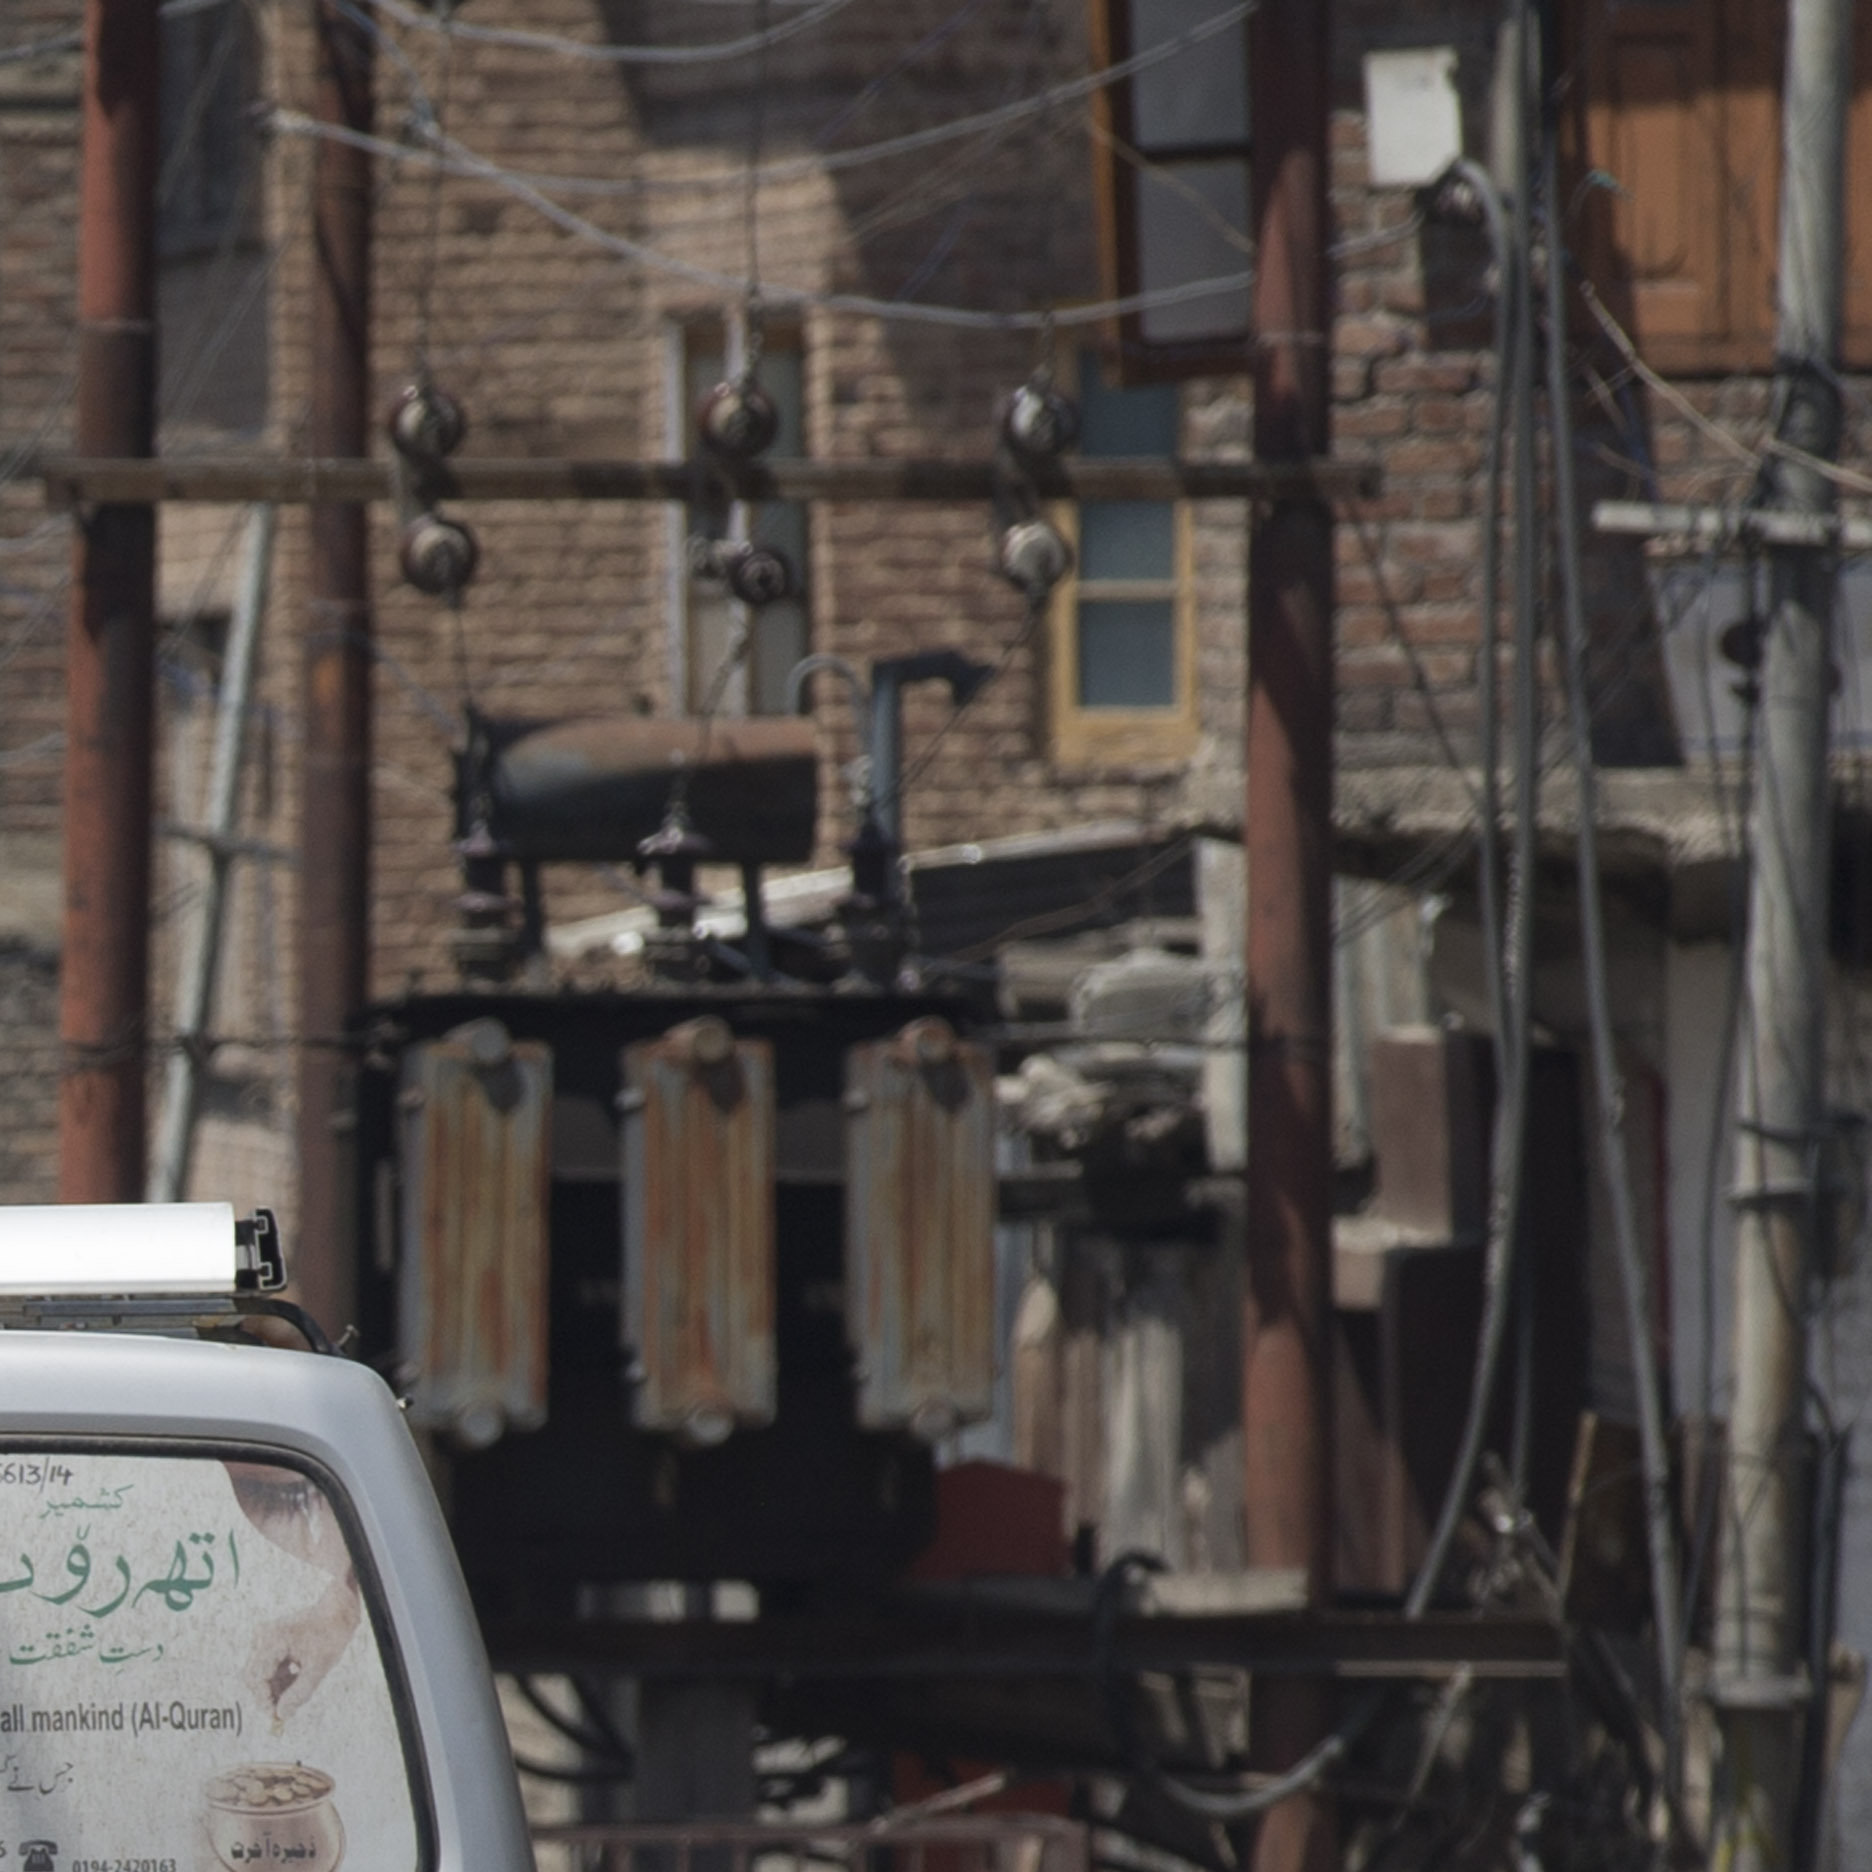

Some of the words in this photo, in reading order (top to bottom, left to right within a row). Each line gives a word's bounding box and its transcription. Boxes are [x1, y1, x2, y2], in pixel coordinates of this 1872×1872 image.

[39, 1485, 134, 1518] کشمیر
[1, 1705, 24, 1733] all
[32, 1704, 124, 1732] mankind
[131, 1703, 243, 1737] (Al-Quran)
